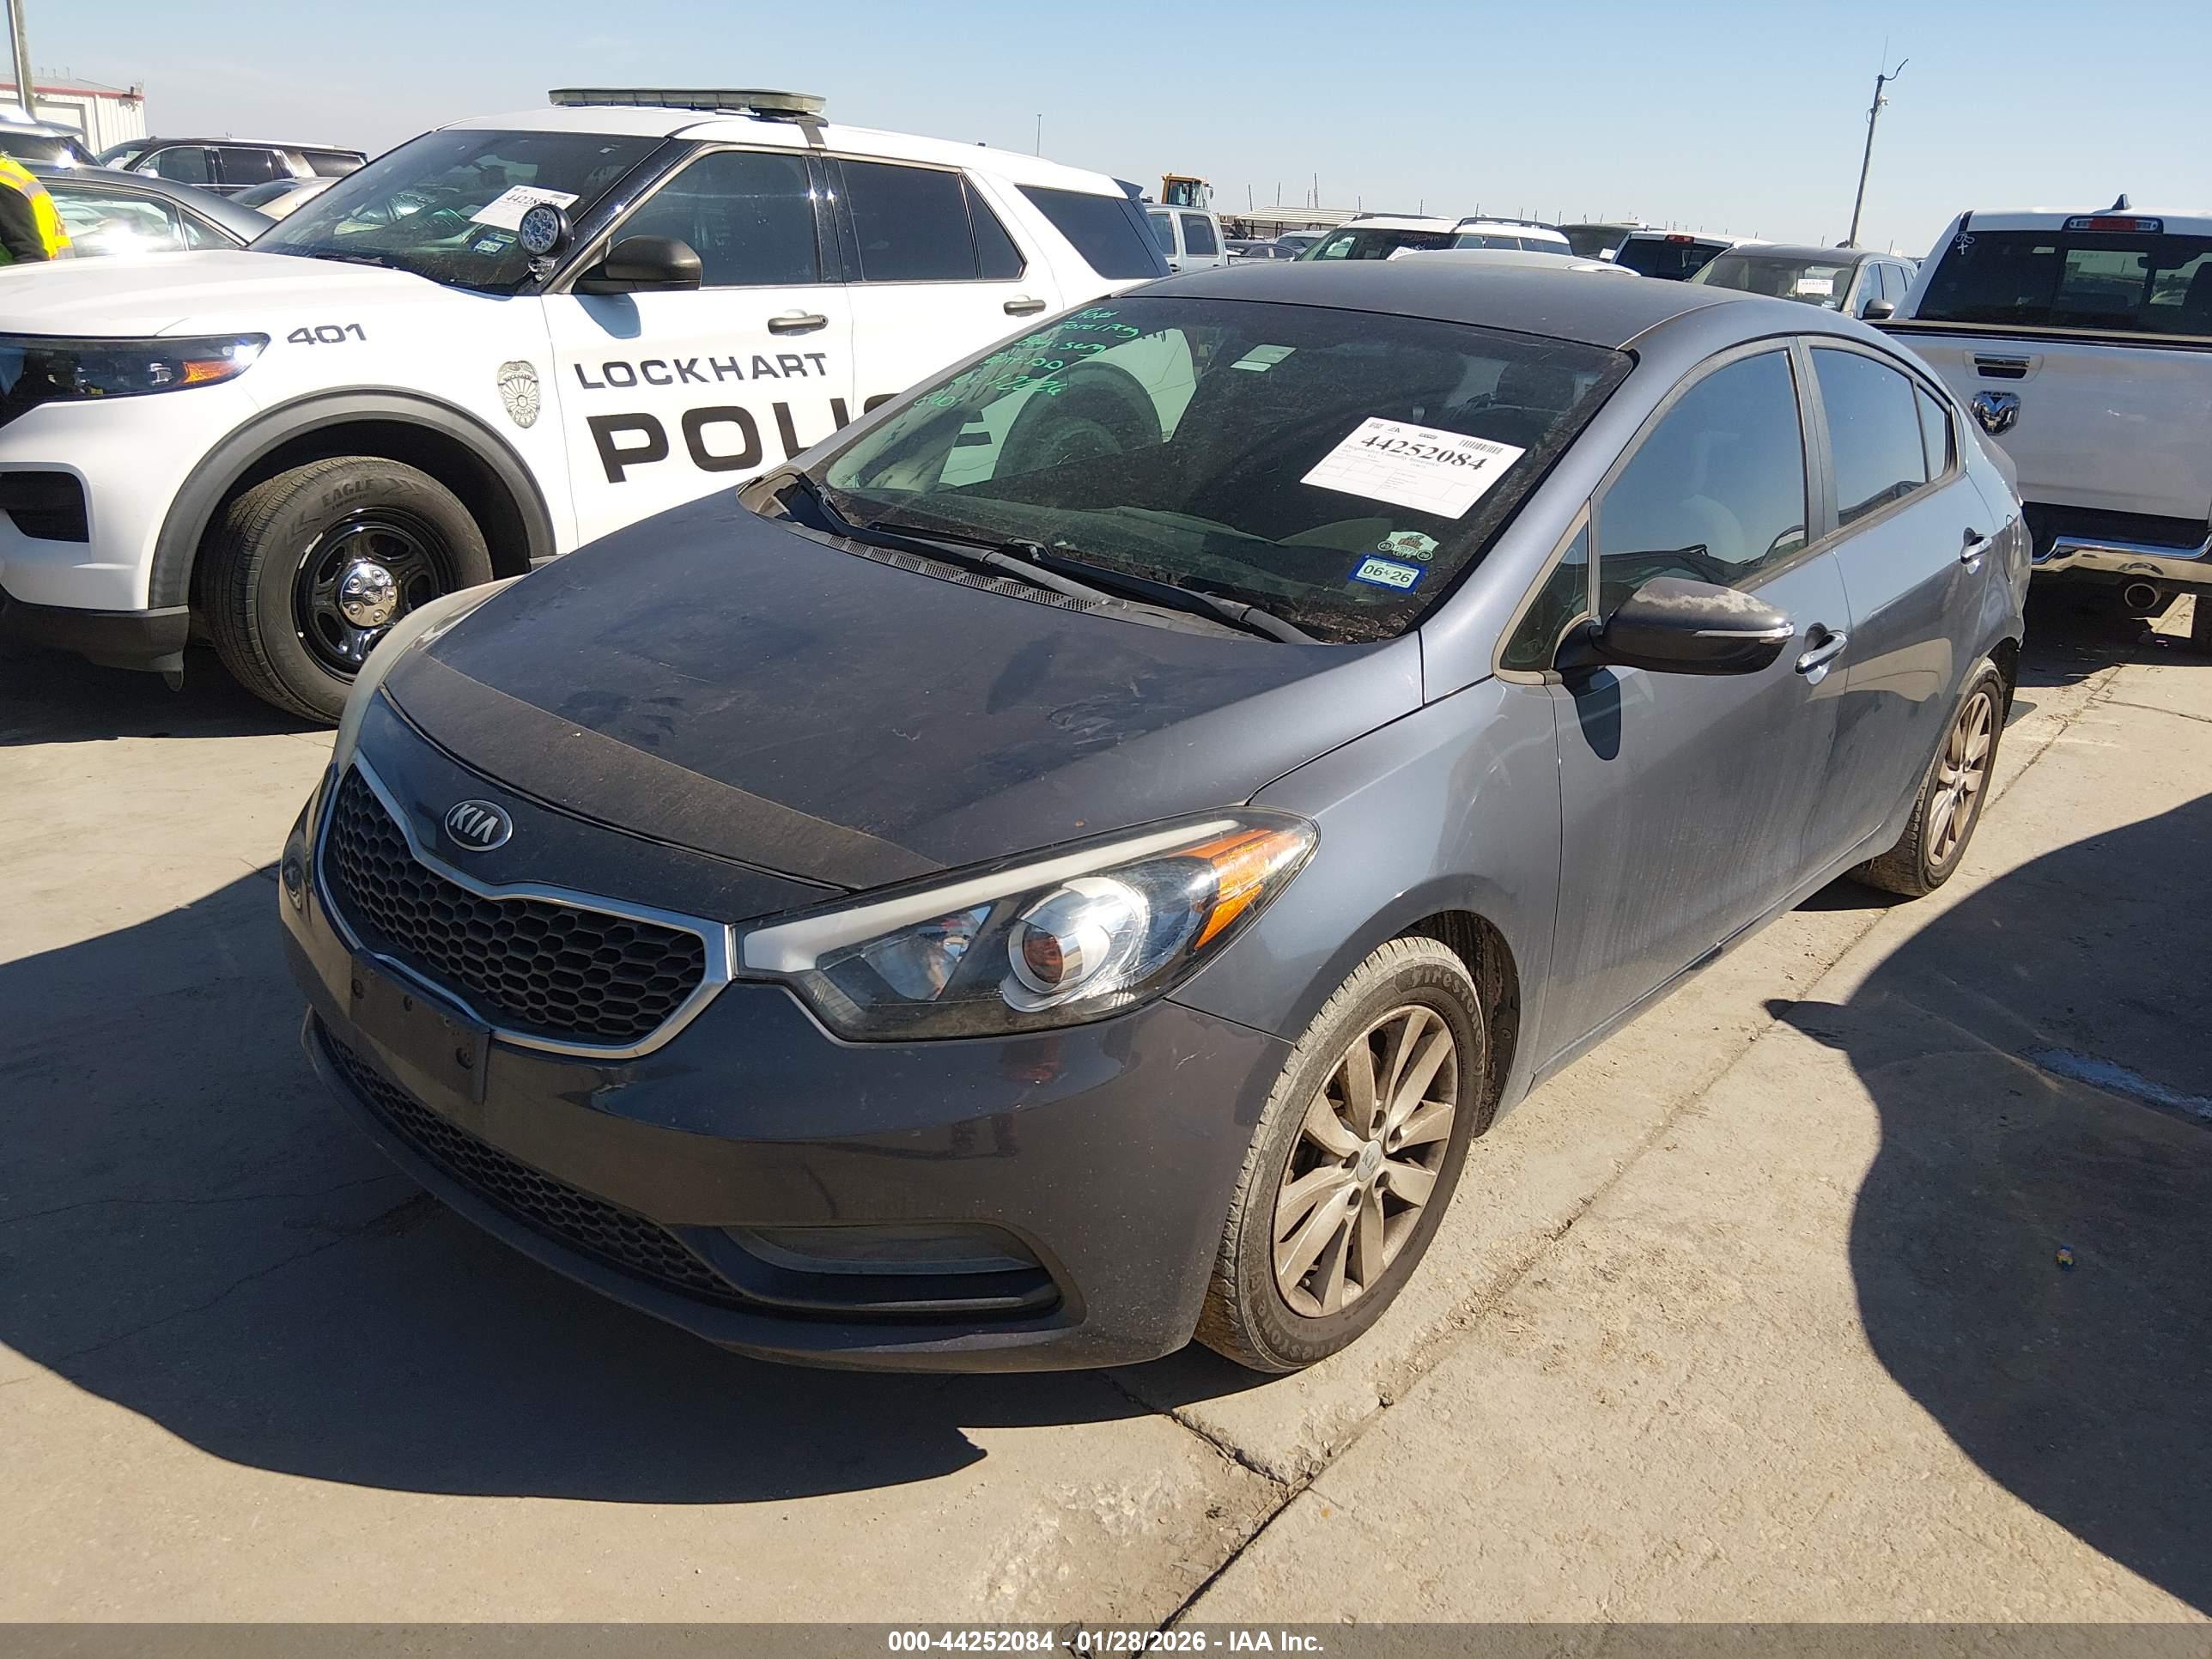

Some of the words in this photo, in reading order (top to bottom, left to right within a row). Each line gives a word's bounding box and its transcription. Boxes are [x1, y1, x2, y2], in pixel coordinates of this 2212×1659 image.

[287, 324, 367, 345] 401
[574, 353, 827, 389] LOCKHART
[1361, 435, 1488, 471] 44252084
[321, 479, 374, 509] EAGLE
[1363, 565, 1385, 577] 06
[1389, 570, 1413, 583] 26
[450, 804, 499, 844] KIA
